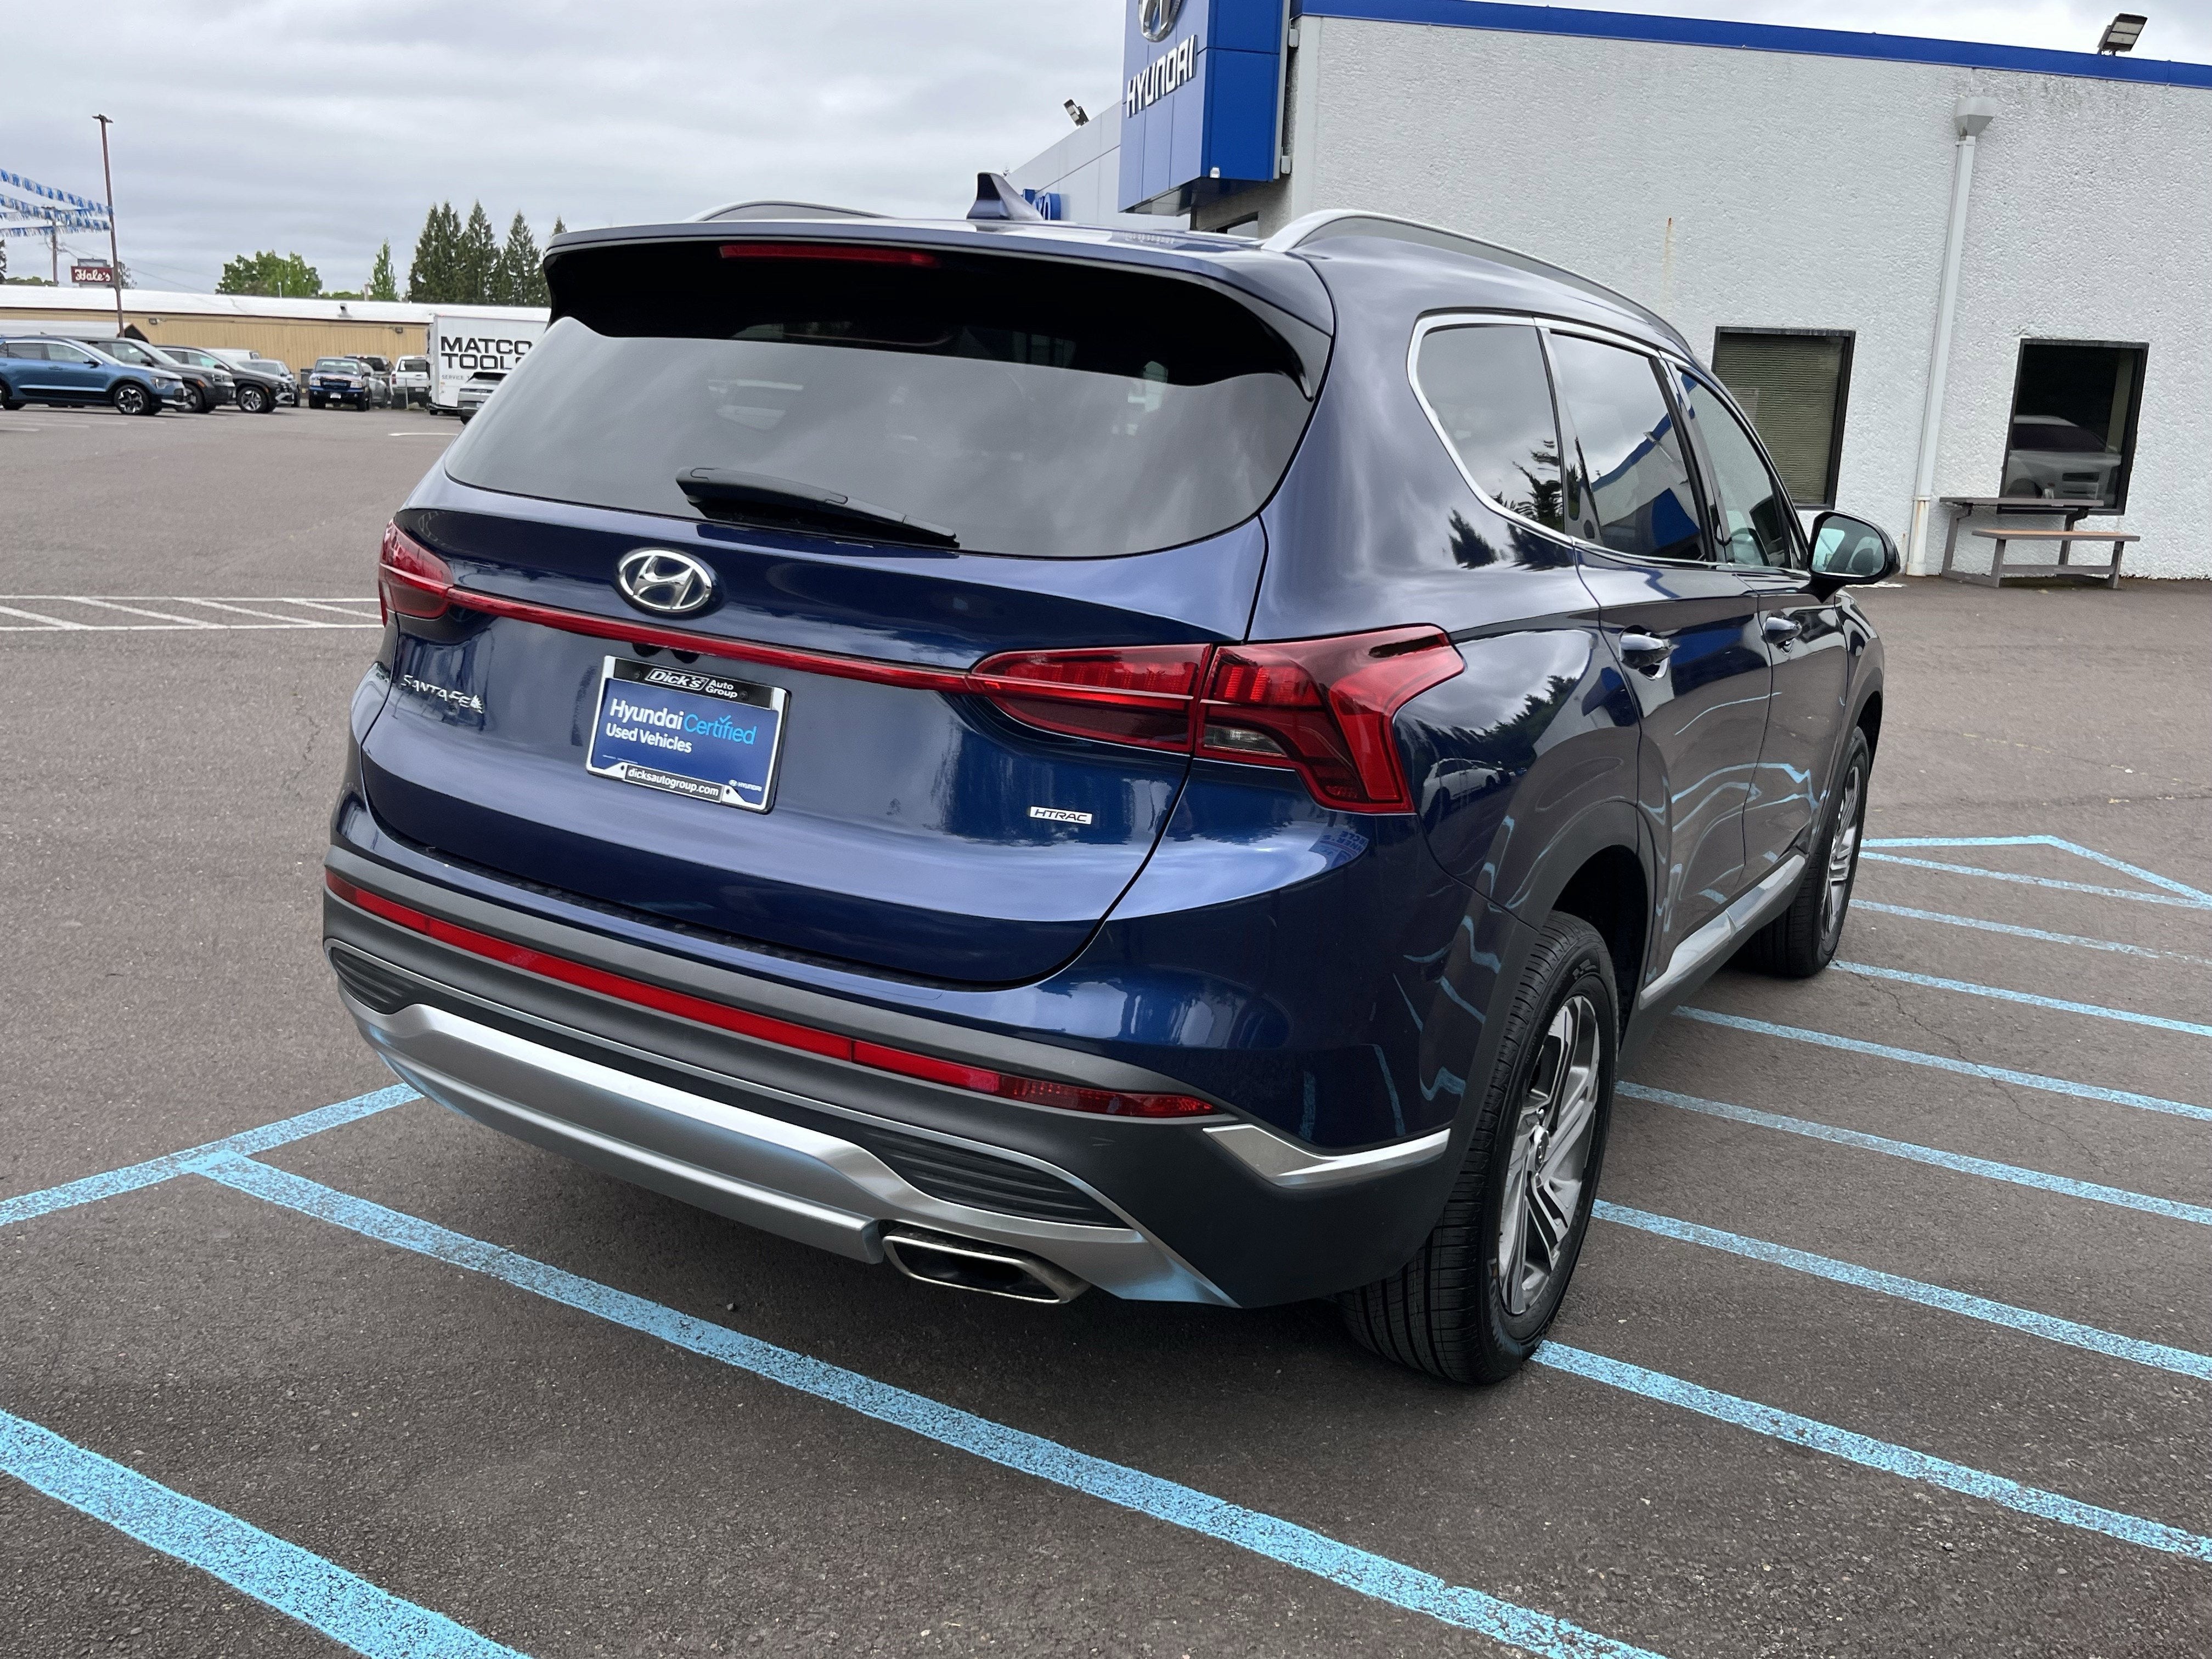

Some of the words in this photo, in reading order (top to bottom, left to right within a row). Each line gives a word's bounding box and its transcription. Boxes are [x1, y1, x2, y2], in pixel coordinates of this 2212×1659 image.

[1126, 35, 1197, 118] HYUNDAI
[75, 269, 111, 281] Hale's
[441, 336, 533, 355] MATCO
[441, 352, 523, 370] TOOL
[650, 670, 702, 688] Dick's
[709, 680, 734, 690] Auto
[705, 686, 738, 698] Group
[610, 698, 685, 730] Hyundai
[684, 713, 757, 745] Certified
[606, 722, 639, 742] Used
[640, 729, 692, 753] Vehicles
[628, 768, 719, 797] dicksautogroup.com
[1035, 809, 1087, 822] HTRAC
